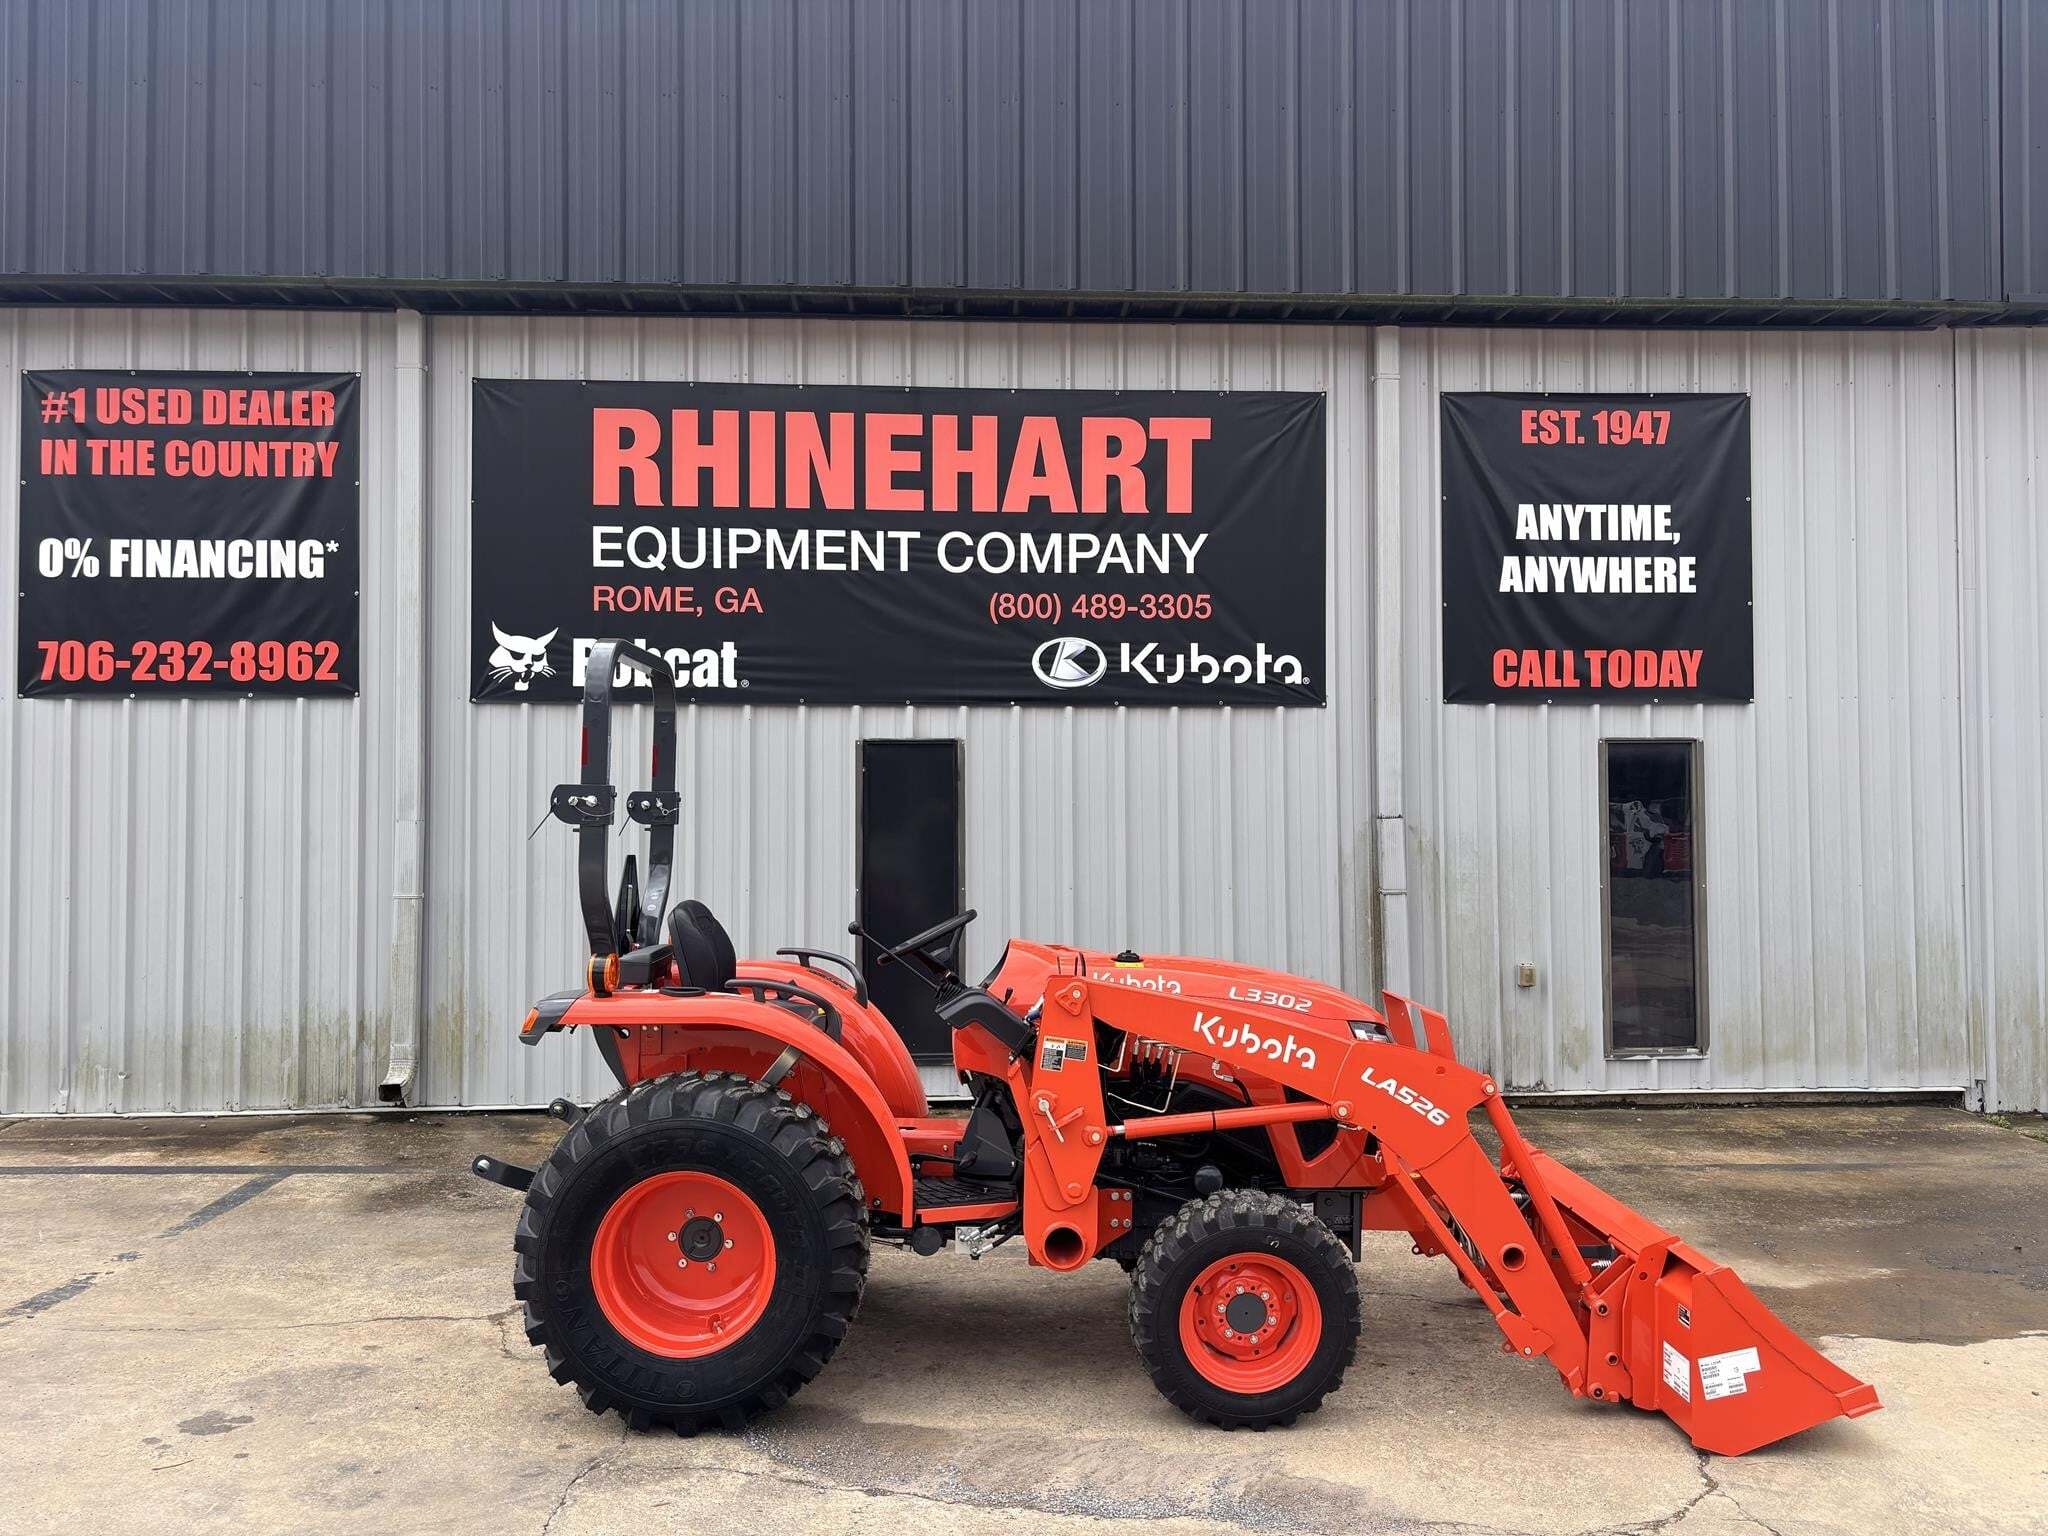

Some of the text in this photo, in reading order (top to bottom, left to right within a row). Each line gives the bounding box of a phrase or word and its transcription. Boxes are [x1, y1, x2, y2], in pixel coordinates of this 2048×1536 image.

[41, 388, 335, 427] #1 USED DEALER
[1521, 410, 1671, 445] EST. 1947
[40, 439, 340, 478] IN THE COUNTRY
[592, 408, 1212, 514] RHINEHART
[1515, 504, 1681, 545] ANYTIME,
[38, 537, 100, 578] 0%
[592, 525, 1209, 574] EQUIPMENT COMPANY
[1499, 556, 1697, 594] ANYWHERE
[593, 585, 764, 617] ROME, GA
[989, 593, 1212, 625] (800) 489-3305
[38, 640, 340, 682] 706-232-8962
[1120, 642, 1303, 685] Kubota
[1493, 648, 1703, 689] CALL TODAY
[1229, 985, 1313, 1013] L3302
[1192, 1010, 1317, 1071] Kubota
[1360, 1066, 1451, 1127] LA526
